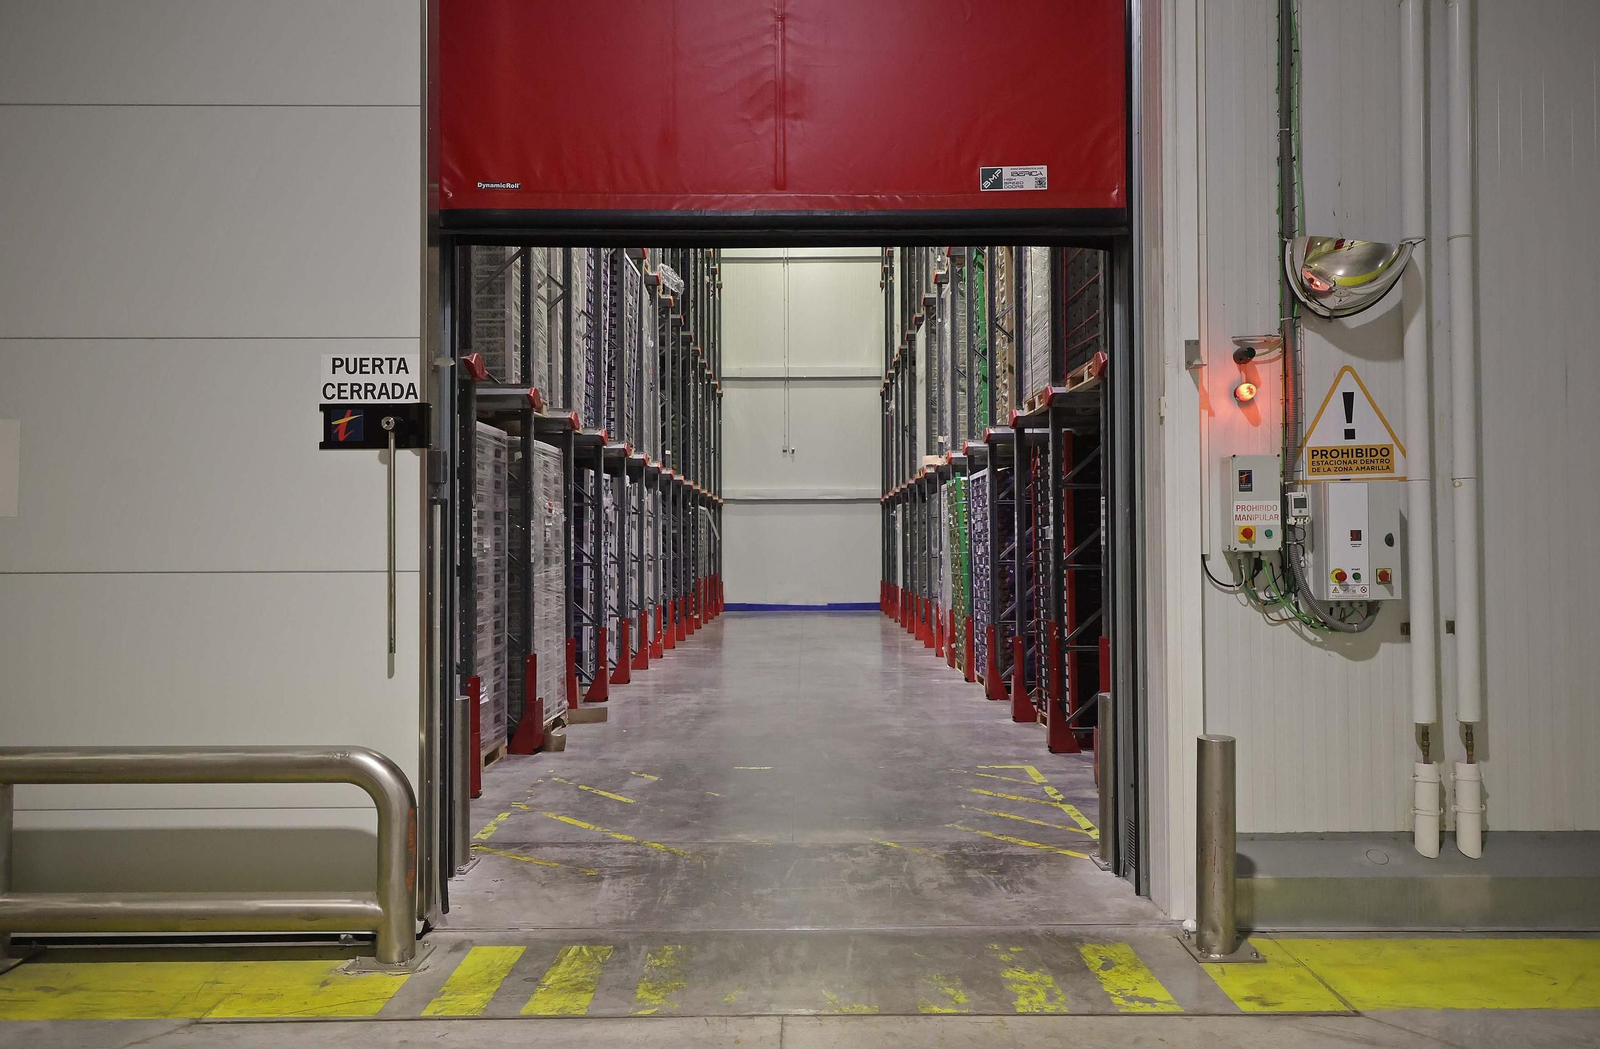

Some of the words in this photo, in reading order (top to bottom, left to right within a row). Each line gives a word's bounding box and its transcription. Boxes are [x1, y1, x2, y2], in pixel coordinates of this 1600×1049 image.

[982, 168, 1002, 189] BMP
[332, 357, 409, 374] PUERTA
[322, 382, 419, 400] CERRADA
[1311, 447, 1390, 459] PROHIBIDO
[1236, 504, 1278, 512] PROHIBIDO
[1235, 513, 1280, 521] MANIPULAR
